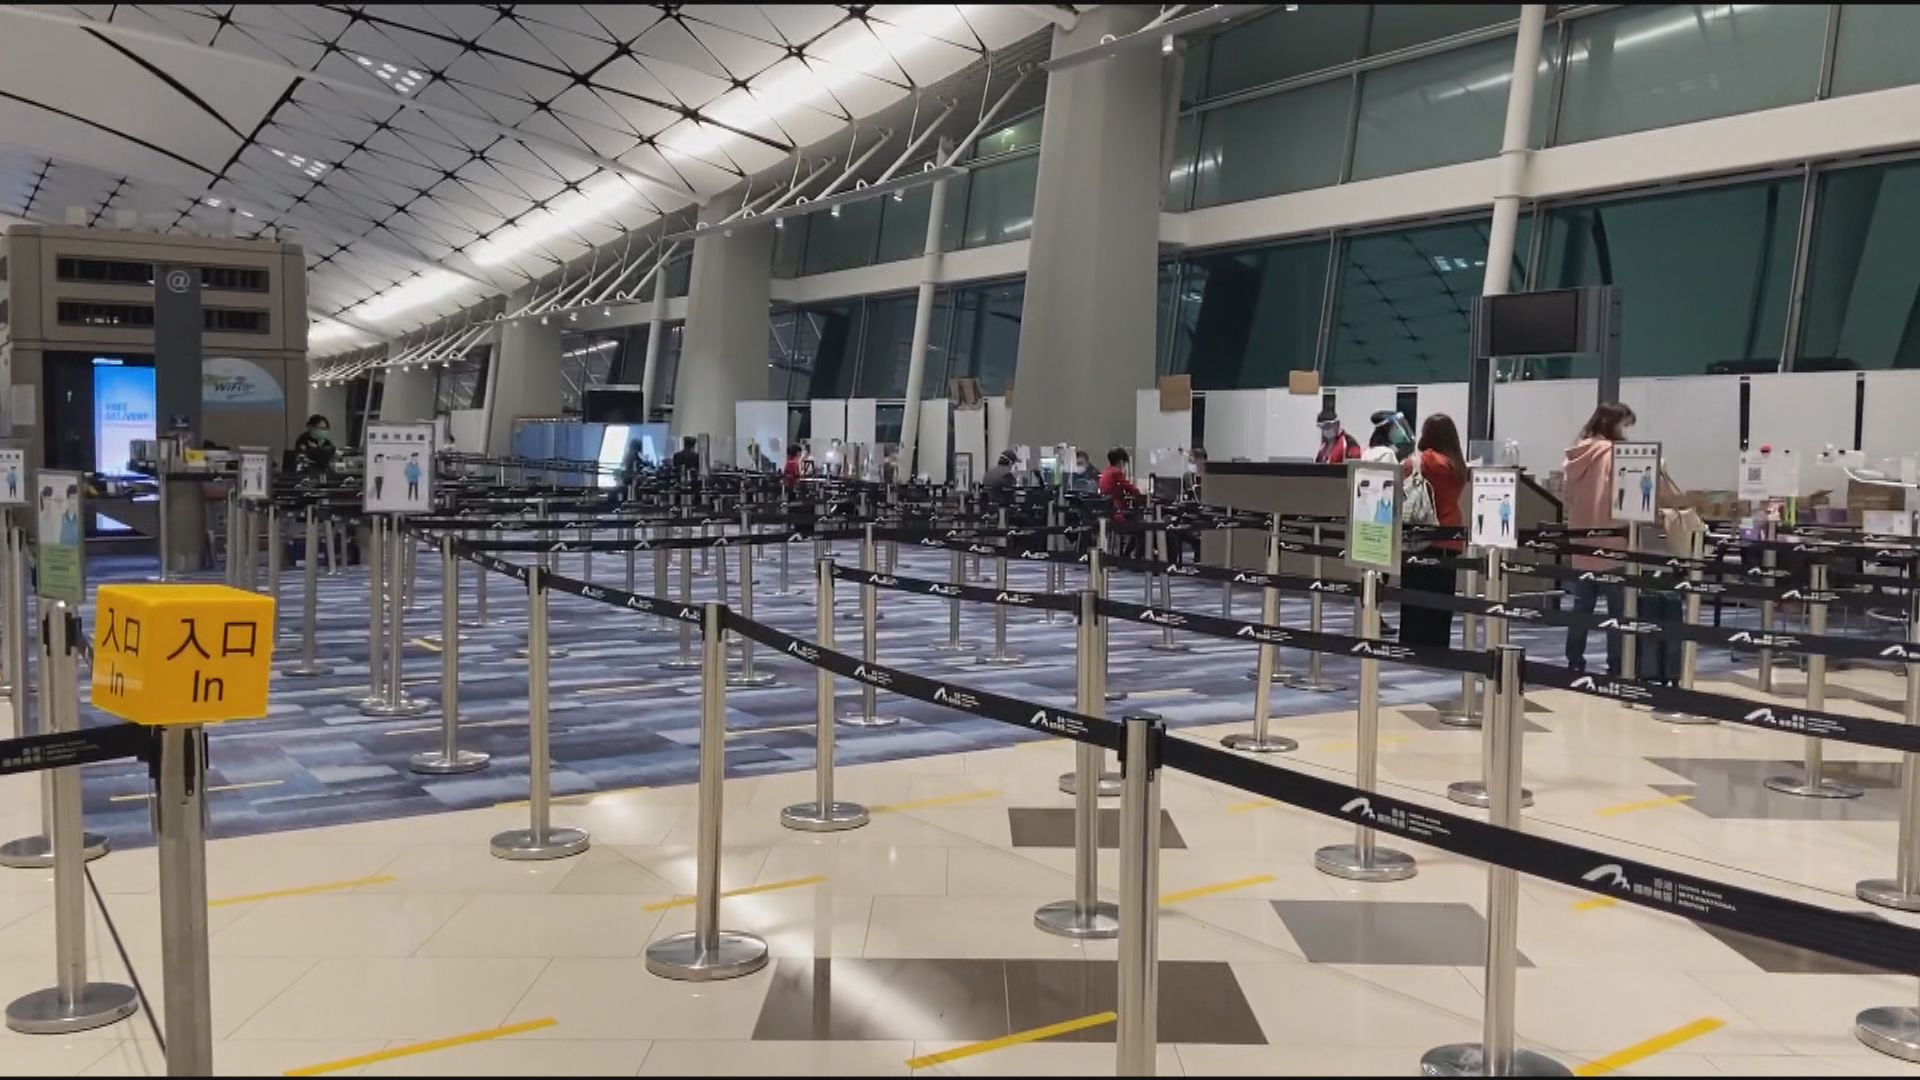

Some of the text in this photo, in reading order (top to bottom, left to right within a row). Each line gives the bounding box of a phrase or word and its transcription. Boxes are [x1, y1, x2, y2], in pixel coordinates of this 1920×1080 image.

[166, 270, 191, 293] @
[102, 608, 140, 657] 入口
[166, 618, 257, 661] 入口
[110, 661, 125, 698] In
[192, 670, 224, 703] In
